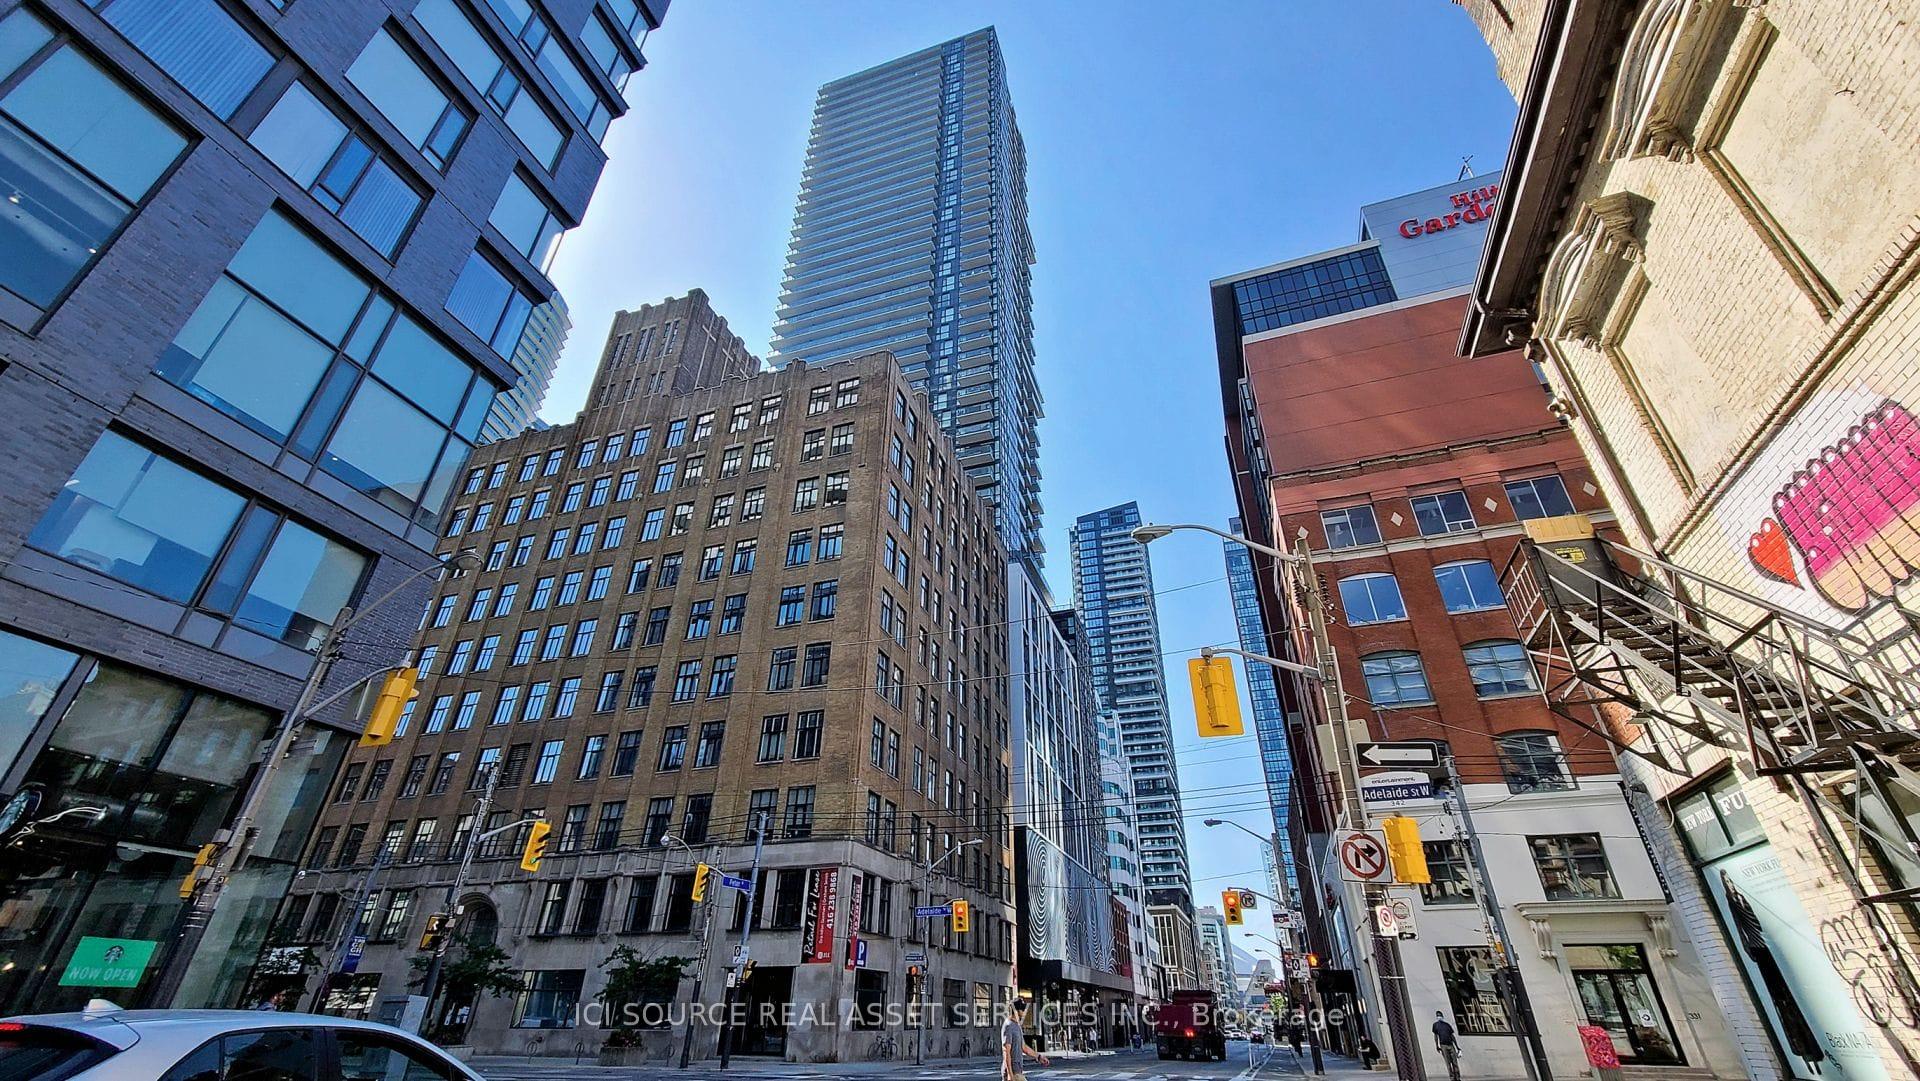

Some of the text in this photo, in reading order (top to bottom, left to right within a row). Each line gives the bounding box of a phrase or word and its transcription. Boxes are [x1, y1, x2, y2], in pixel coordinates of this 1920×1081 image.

[1364, 785, 1429, 800] Adelaide St W
[1718, 789, 1750, 816] FU
[807, 901, 818, 917] For
[826, 912, 834, 929] 416
[68, 966, 138, 982] NOW OPEN
